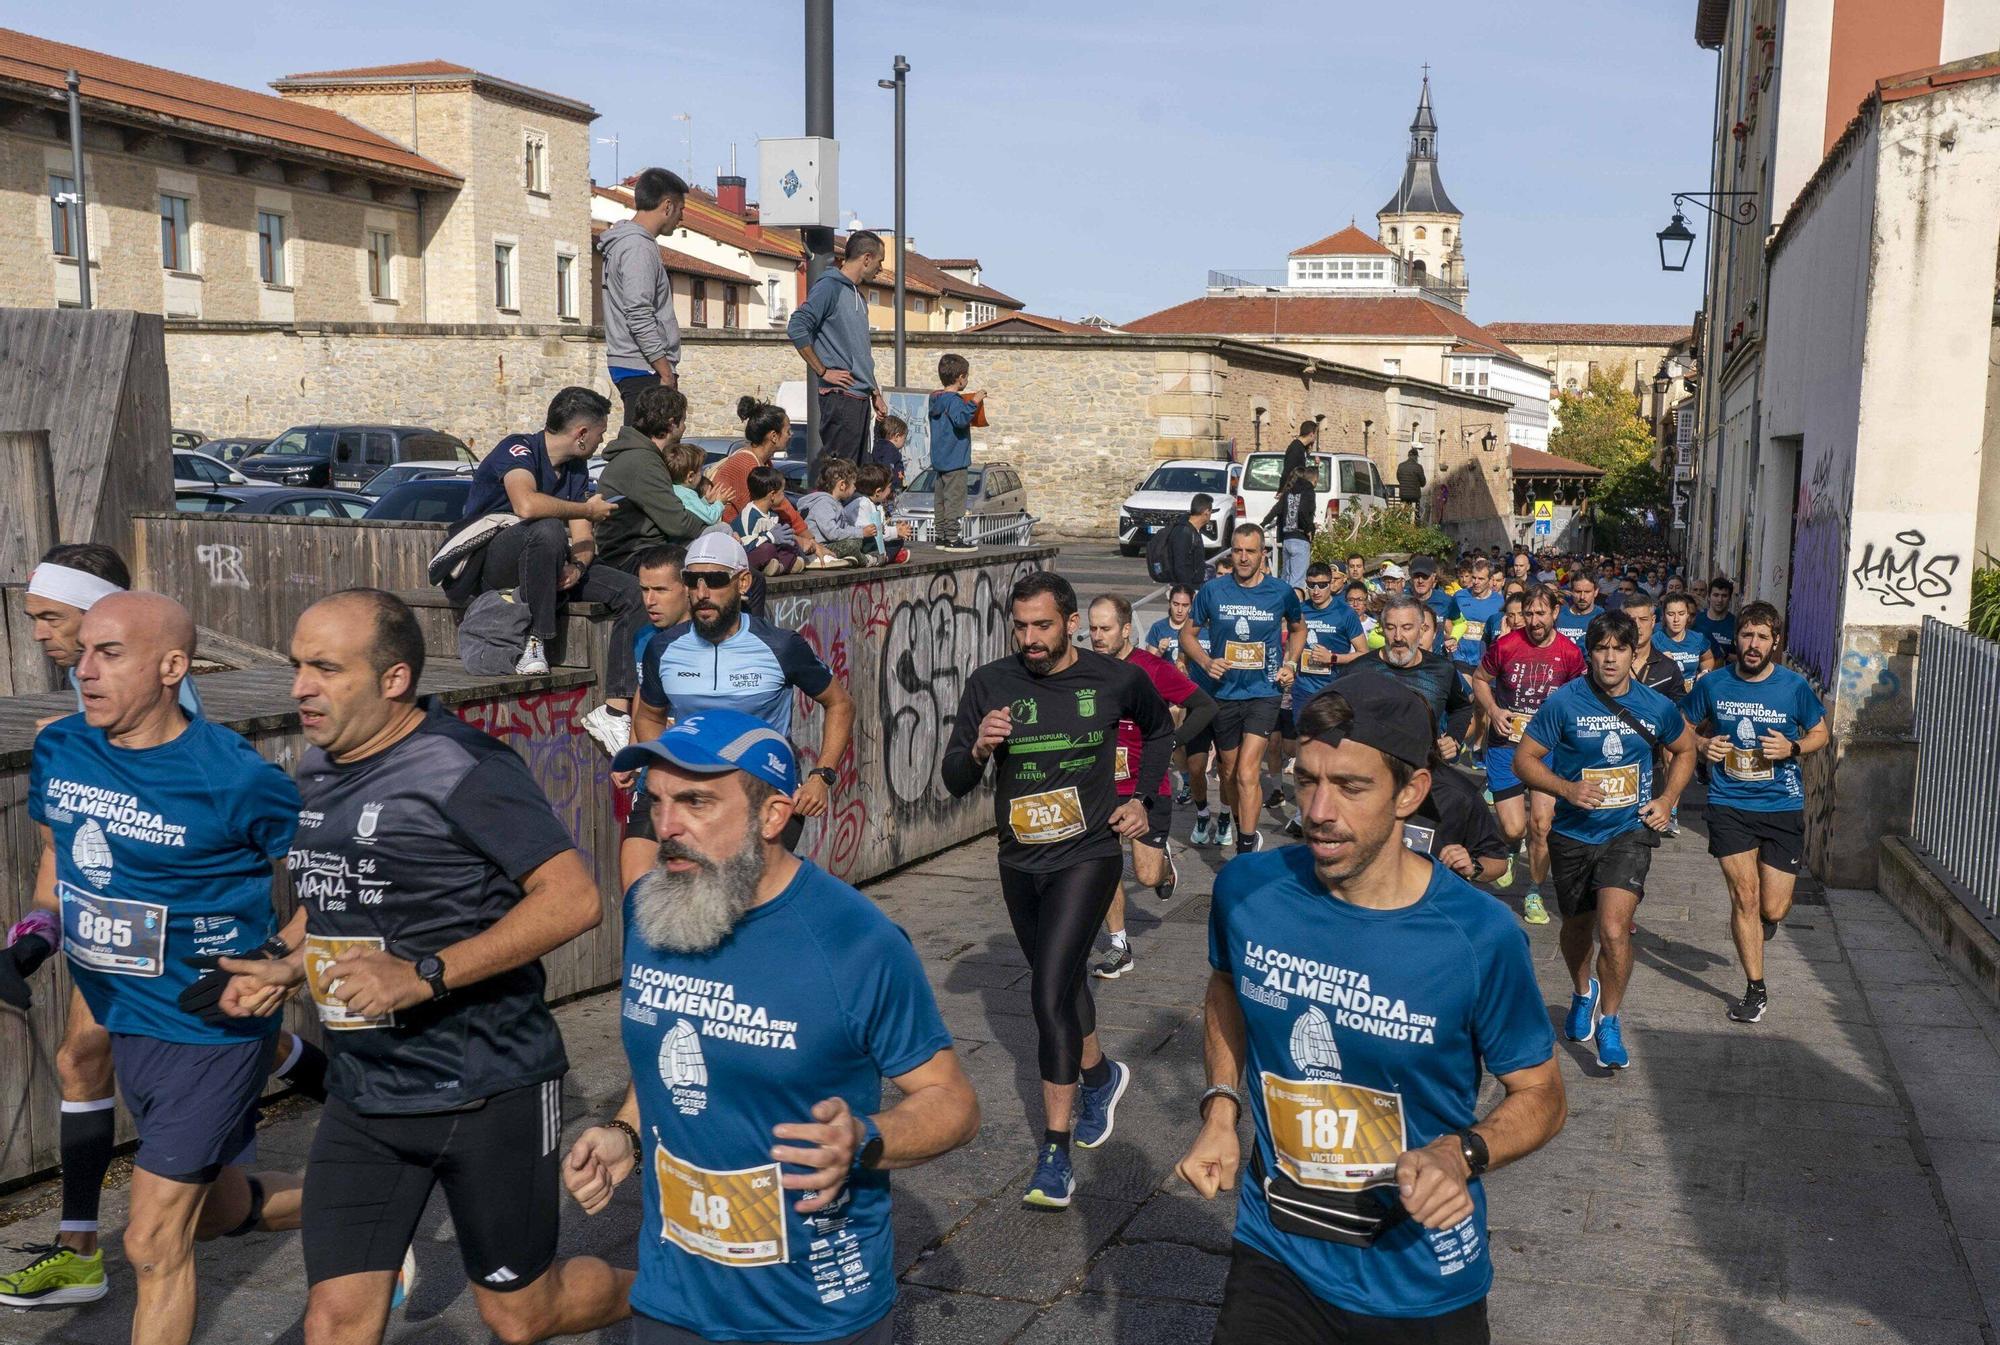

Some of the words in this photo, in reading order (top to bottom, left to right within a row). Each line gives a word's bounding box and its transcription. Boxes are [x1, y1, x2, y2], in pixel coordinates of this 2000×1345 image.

[1235, 650, 1256, 660] 562
[1725, 701, 1764, 709] CONQUISTA
[1726, 707, 1778, 717] ALMENDRA
[1752, 716, 1787, 724] KONKISTA
[1087, 730, 1104, 743] 10K
[1015, 771, 1046, 781] LEYENDA
[48, 777, 60, 790] LA
[60, 780, 138, 809] CONQUISTA
[58, 794, 163, 831] ALMENDRA
[1026, 803, 1063, 828] 252
[106, 820, 186, 847] KONKISTA
[357, 859, 377, 874] 5k
[358, 889, 384, 905] 10k
[78, 910, 132, 947] 885
[1246, 941, 1263, 961] LA
[1264, 949, 1371, 992] CONQUISTA
[631, 963, 642, 980] LA
[641, 967, 735, 1001] CONQUISTA
[1244, 956, 1256, 968] DE
[1255, 959, 1269, 974] LA
[1262, 967, 1409, 1024] ALMENDRA
[1409, 1013, 1437, 1028] REN
[637, 985, 770, 1029] ALMENDRA
[769, 1019, 798, 1032] REN
[701, 1019, 798, 1050] KONKISTA
[1335, 1008, 1435, 1045] KONKISTA
[1305, 1067, 1343, 1081] VITORIA
[672, 1086, 707, 1100] VITORIA
[672, 1096, 708, 1109] GASTEIZ
[1296, 1108, 1359, 1149] 187
[1311, 1152, 1345, 1163] VICTOR
[690, 1190, 731, 1230] 48
